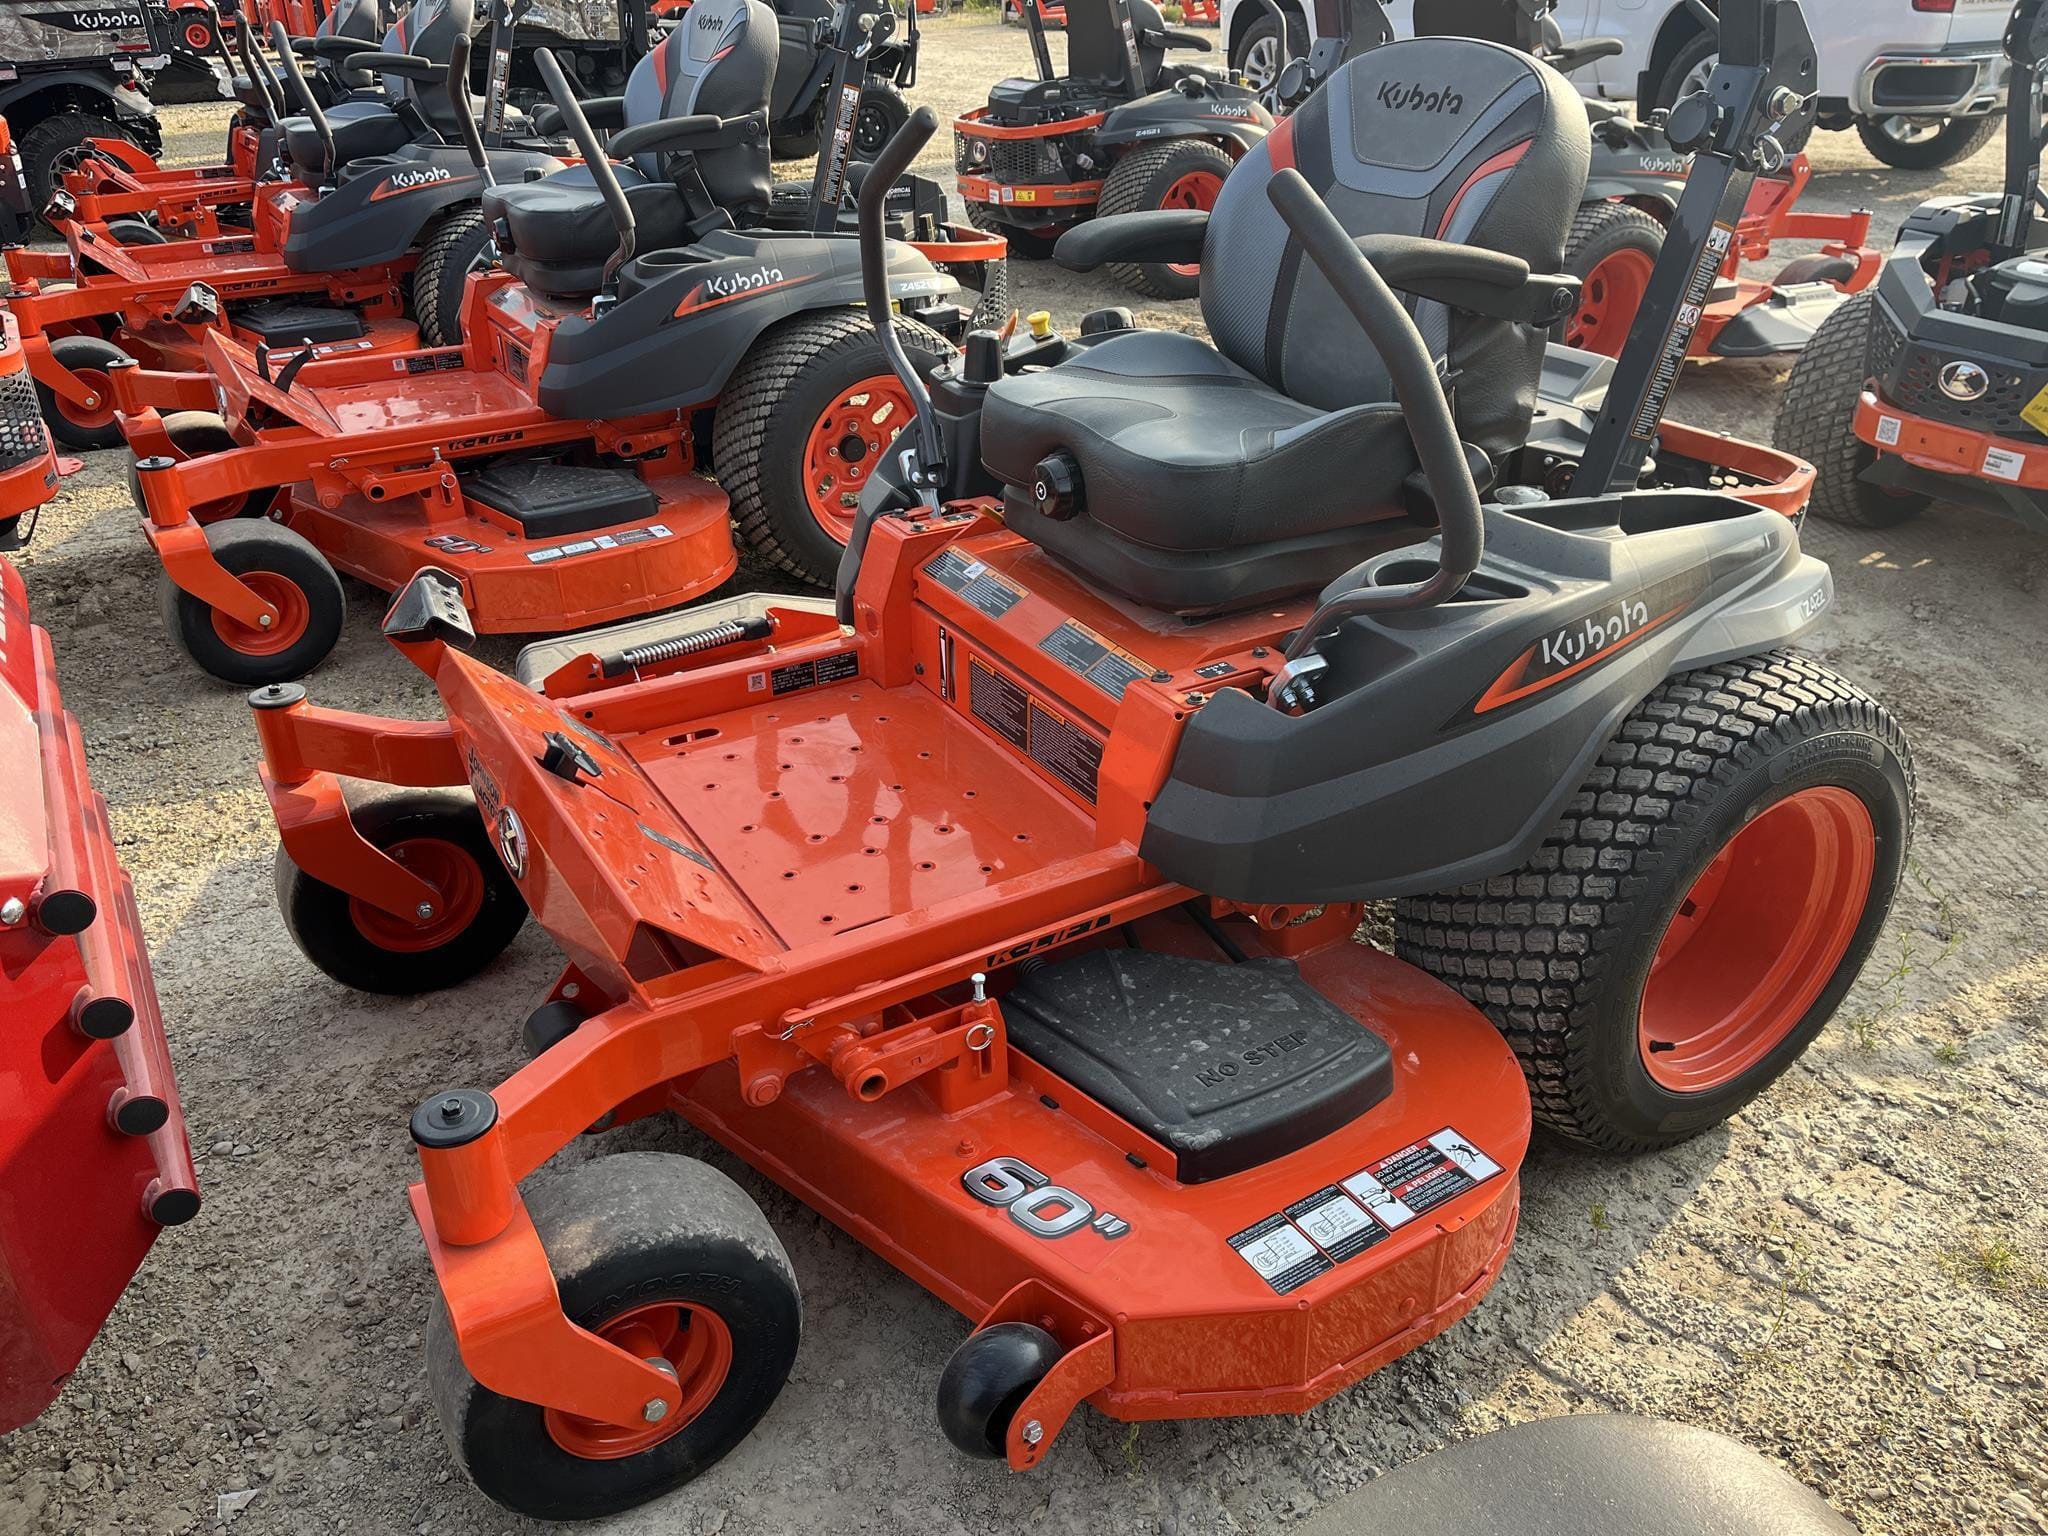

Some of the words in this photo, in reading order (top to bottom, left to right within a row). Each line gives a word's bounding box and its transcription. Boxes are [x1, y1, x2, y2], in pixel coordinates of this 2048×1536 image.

[73, 11, 140, 28] Kubota
[698, 14, 723, 31] Kubota
[1376, 80, 1465, 115] Kubota
[1210, 104, 1248, 117] Kubota
[1639, 156, 1683, 173] Kubota
[391, 166, 451, 188] Kubota
[706, 265, 784, 297] Kubota
[449, 431, 523, 451] K-LIFT
[1802, 587, 1827, 618] Z422
[1541, 600, 1649, 666] Kubota
[468, 747, 500, 805] JOHNSON
[986, 913, 1112, 968] K-LIFT
[1194, 1061, 1240, 1087] NO
[1243, 1029, 1308, 1066] STEP
[1380, 1173, 1396, 1183] FEET
[1392, 1167, 1407, 1177] INTO
[1404, 1157, 1426, 1171] MOWER
[1423, 1150, 1441, 1161] WHEN
[1382, 1165, 1395, 1174] NOT
[1392, 1160, 1406, 1168] PUT
[1403, 1152, 1421, 1163] HANDS
[1419, 1147, 1430, 1155] OR
[1384, 1144, 1420, 1165] DANGER
[1386, 1176, 1408, 1188] ENGINE
[1410, 1165, 1448, 1187] PELIGRO
